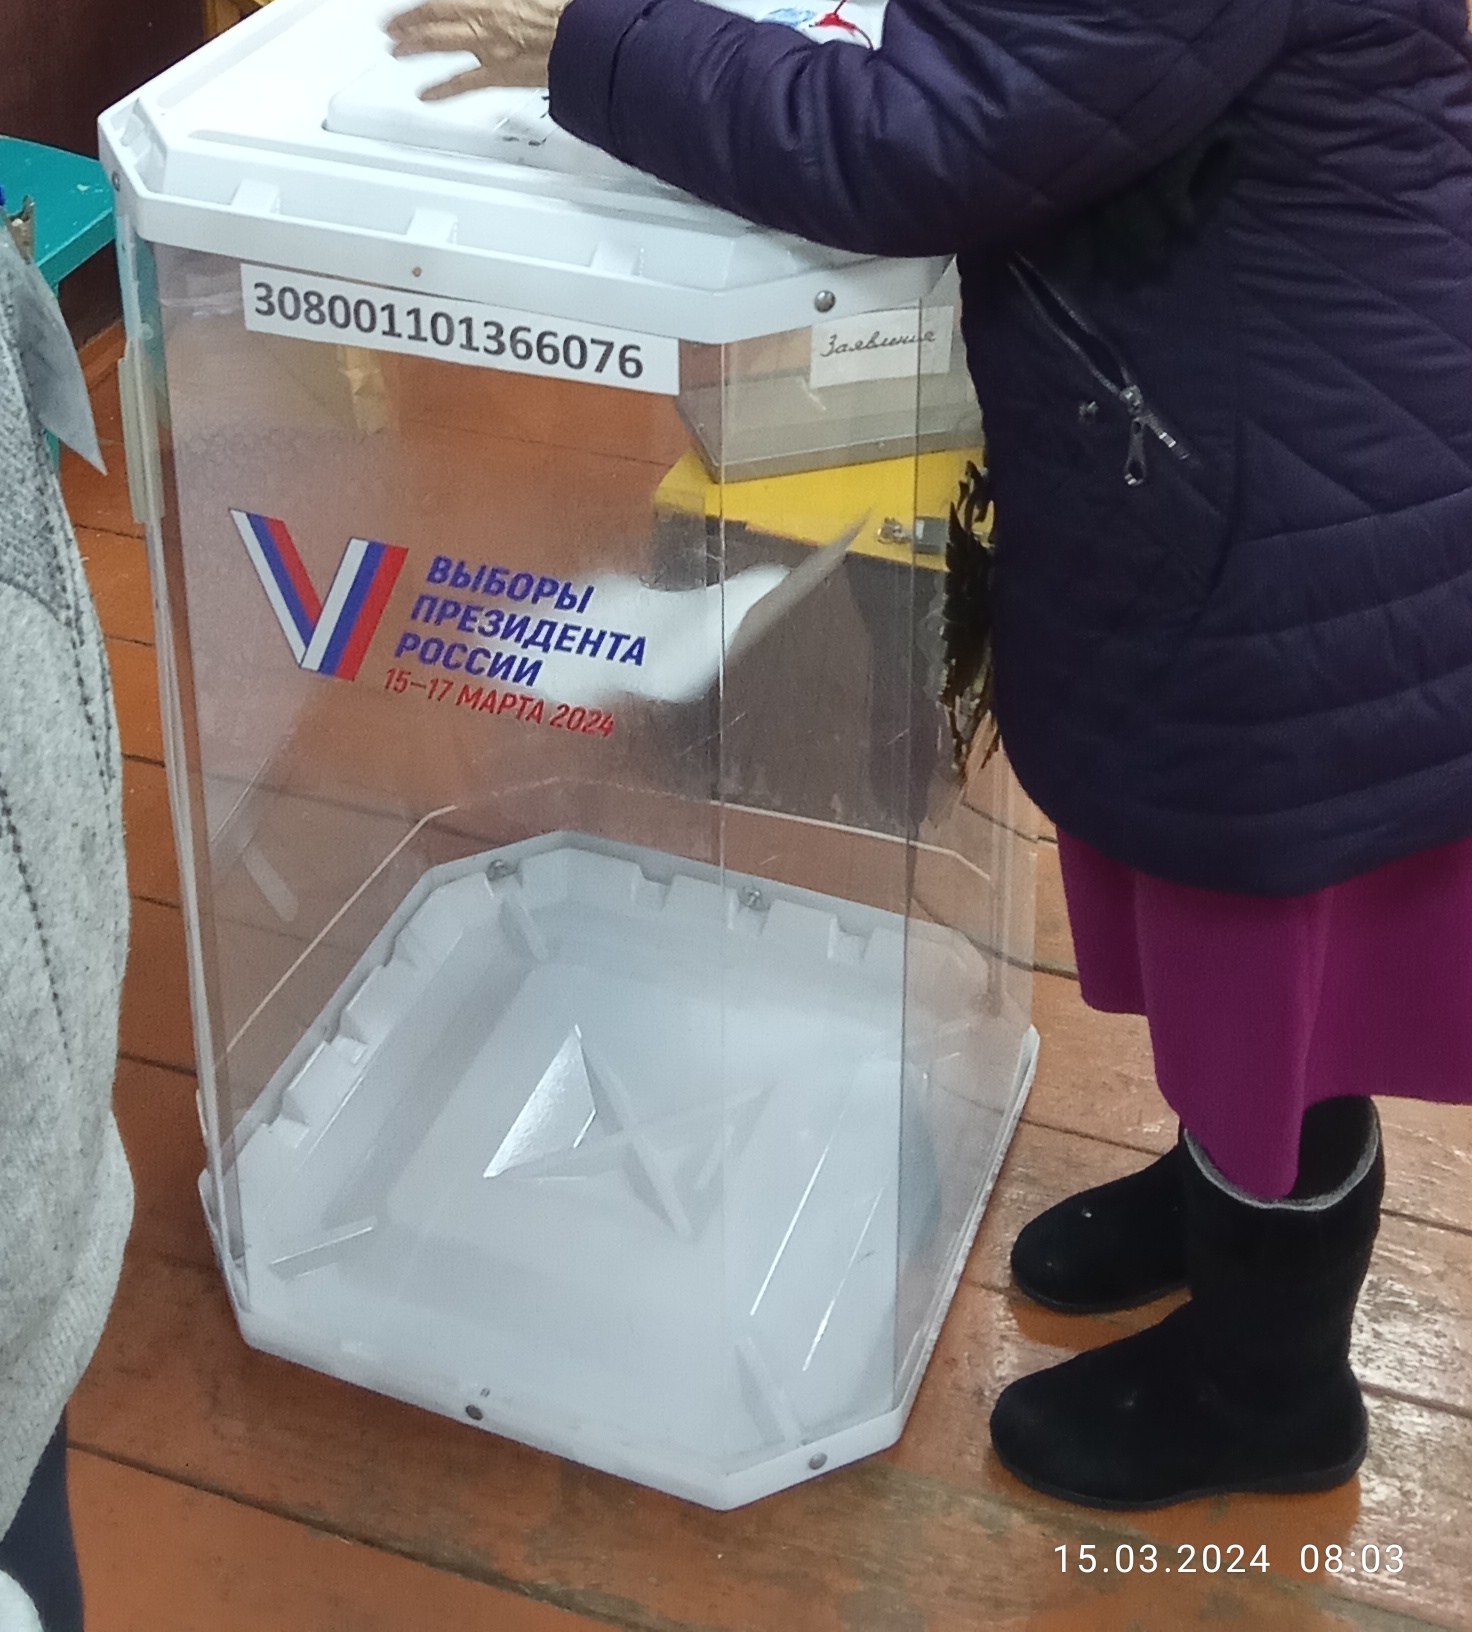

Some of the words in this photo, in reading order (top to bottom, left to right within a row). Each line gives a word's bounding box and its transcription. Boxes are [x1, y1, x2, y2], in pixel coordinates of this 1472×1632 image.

[253, 281, 644, 379] 308001101366076
[427, 555, 595, 614] ВЫБОРЫ
[395, 632, 544, 687] РОССИИ
[410, 594, 647, 667] ПРЕЗИДЕНТА
[456, 684, 546, 725] МАРТА
[549, 703, 615, 737] 2024
